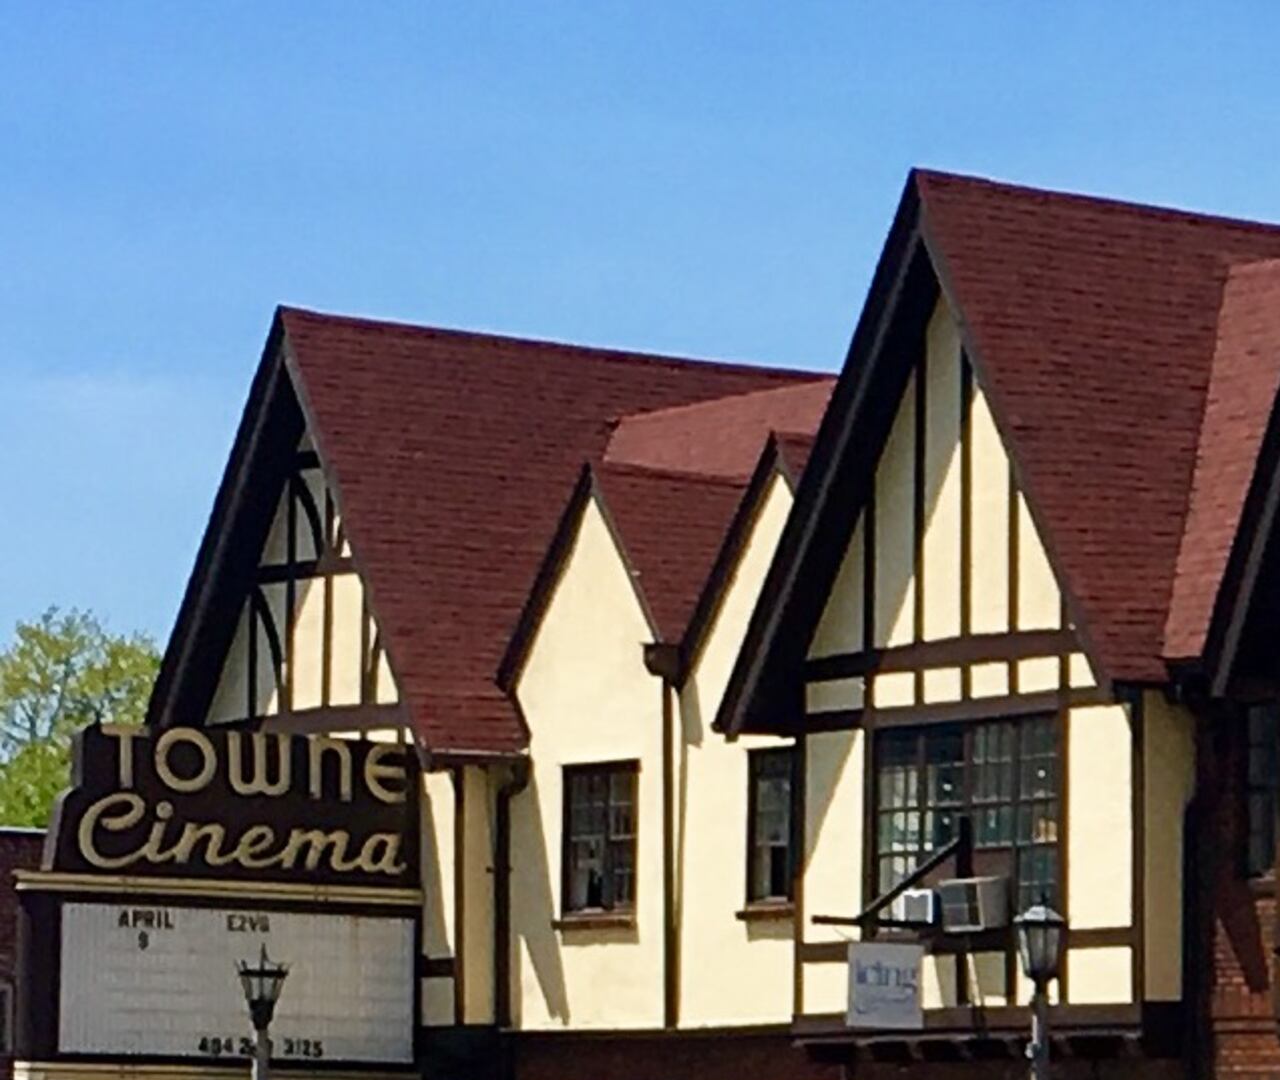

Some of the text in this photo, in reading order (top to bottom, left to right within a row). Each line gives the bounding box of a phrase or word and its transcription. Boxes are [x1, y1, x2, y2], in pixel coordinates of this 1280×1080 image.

[101, 726, 407, 804] TOWNE
[78, 792, 407, 875] Cinema
[118, 904, 175, 930] APRIL
